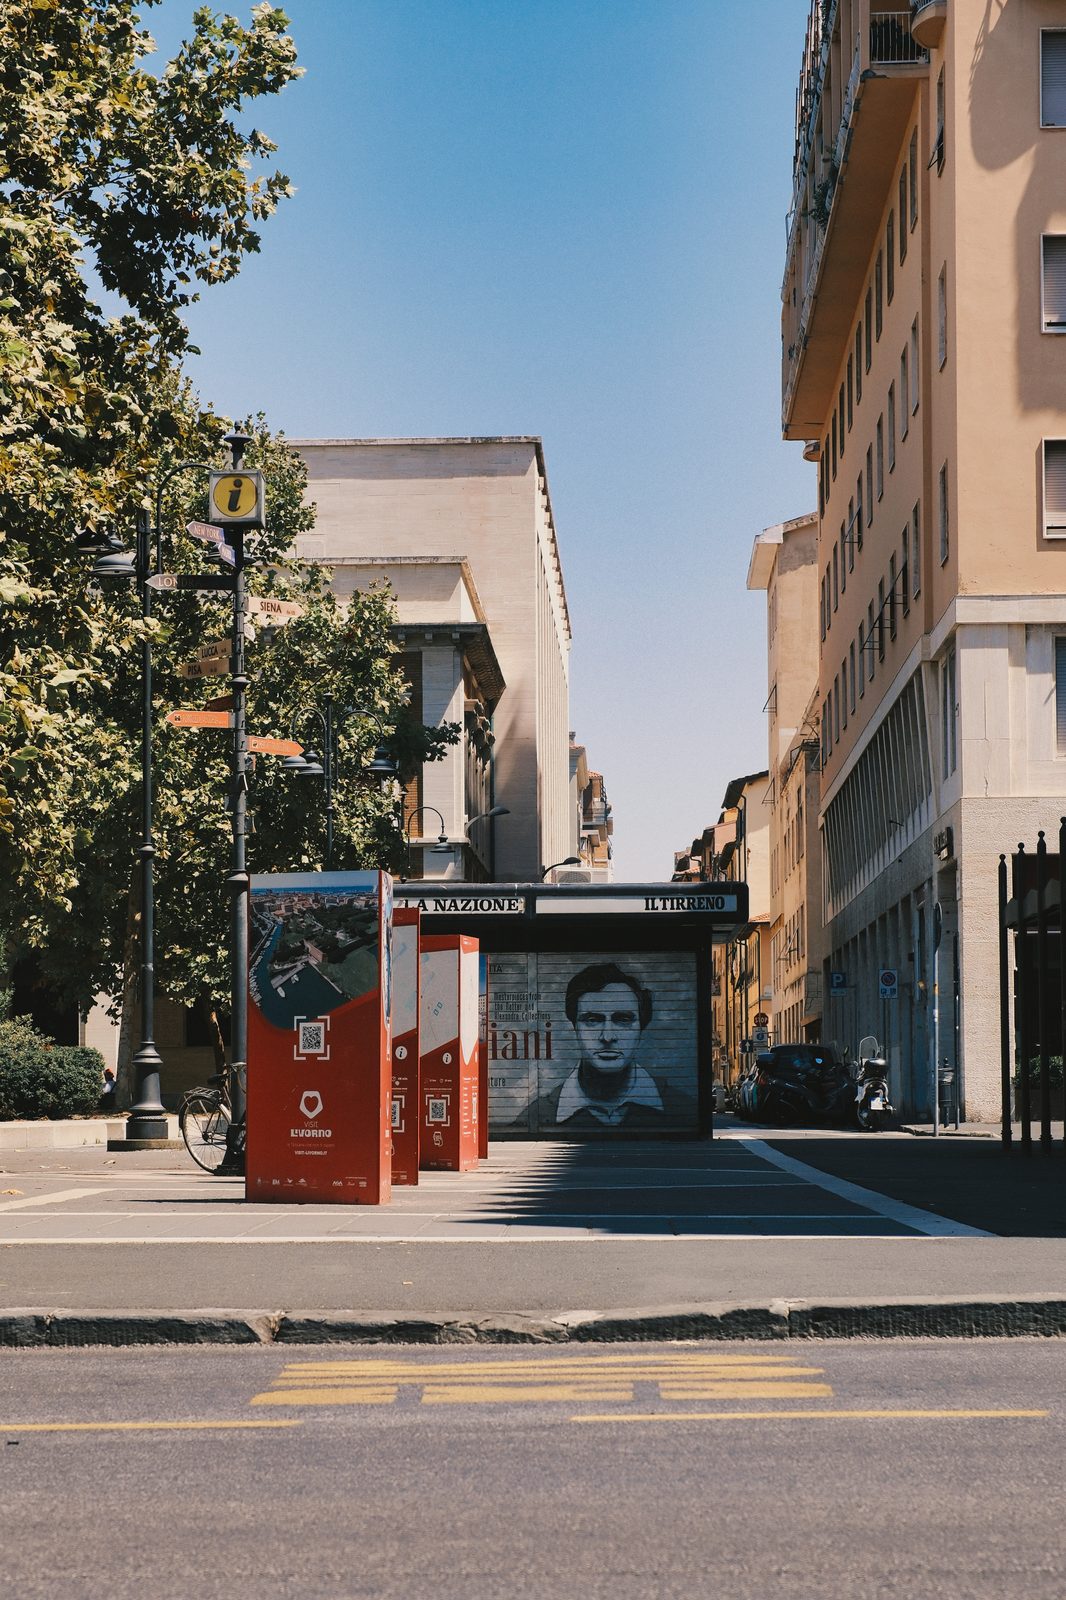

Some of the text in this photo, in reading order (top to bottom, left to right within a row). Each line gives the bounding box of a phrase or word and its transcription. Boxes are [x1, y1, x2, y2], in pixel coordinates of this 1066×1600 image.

[193, 524, 220, 540] NEW YORK
[259, 601, 282, 614] SIENA
[201, 645, 219, 658] LUCCA
[187, 664, 203, 676] PISA
[433, 898, 519, 912] NAZIONE
[644, 896, 726, 911] IL TIRRENO
[754, 1016, 768, 1024] STOP
[290, 1128, 332, 1138] LIVORNO
